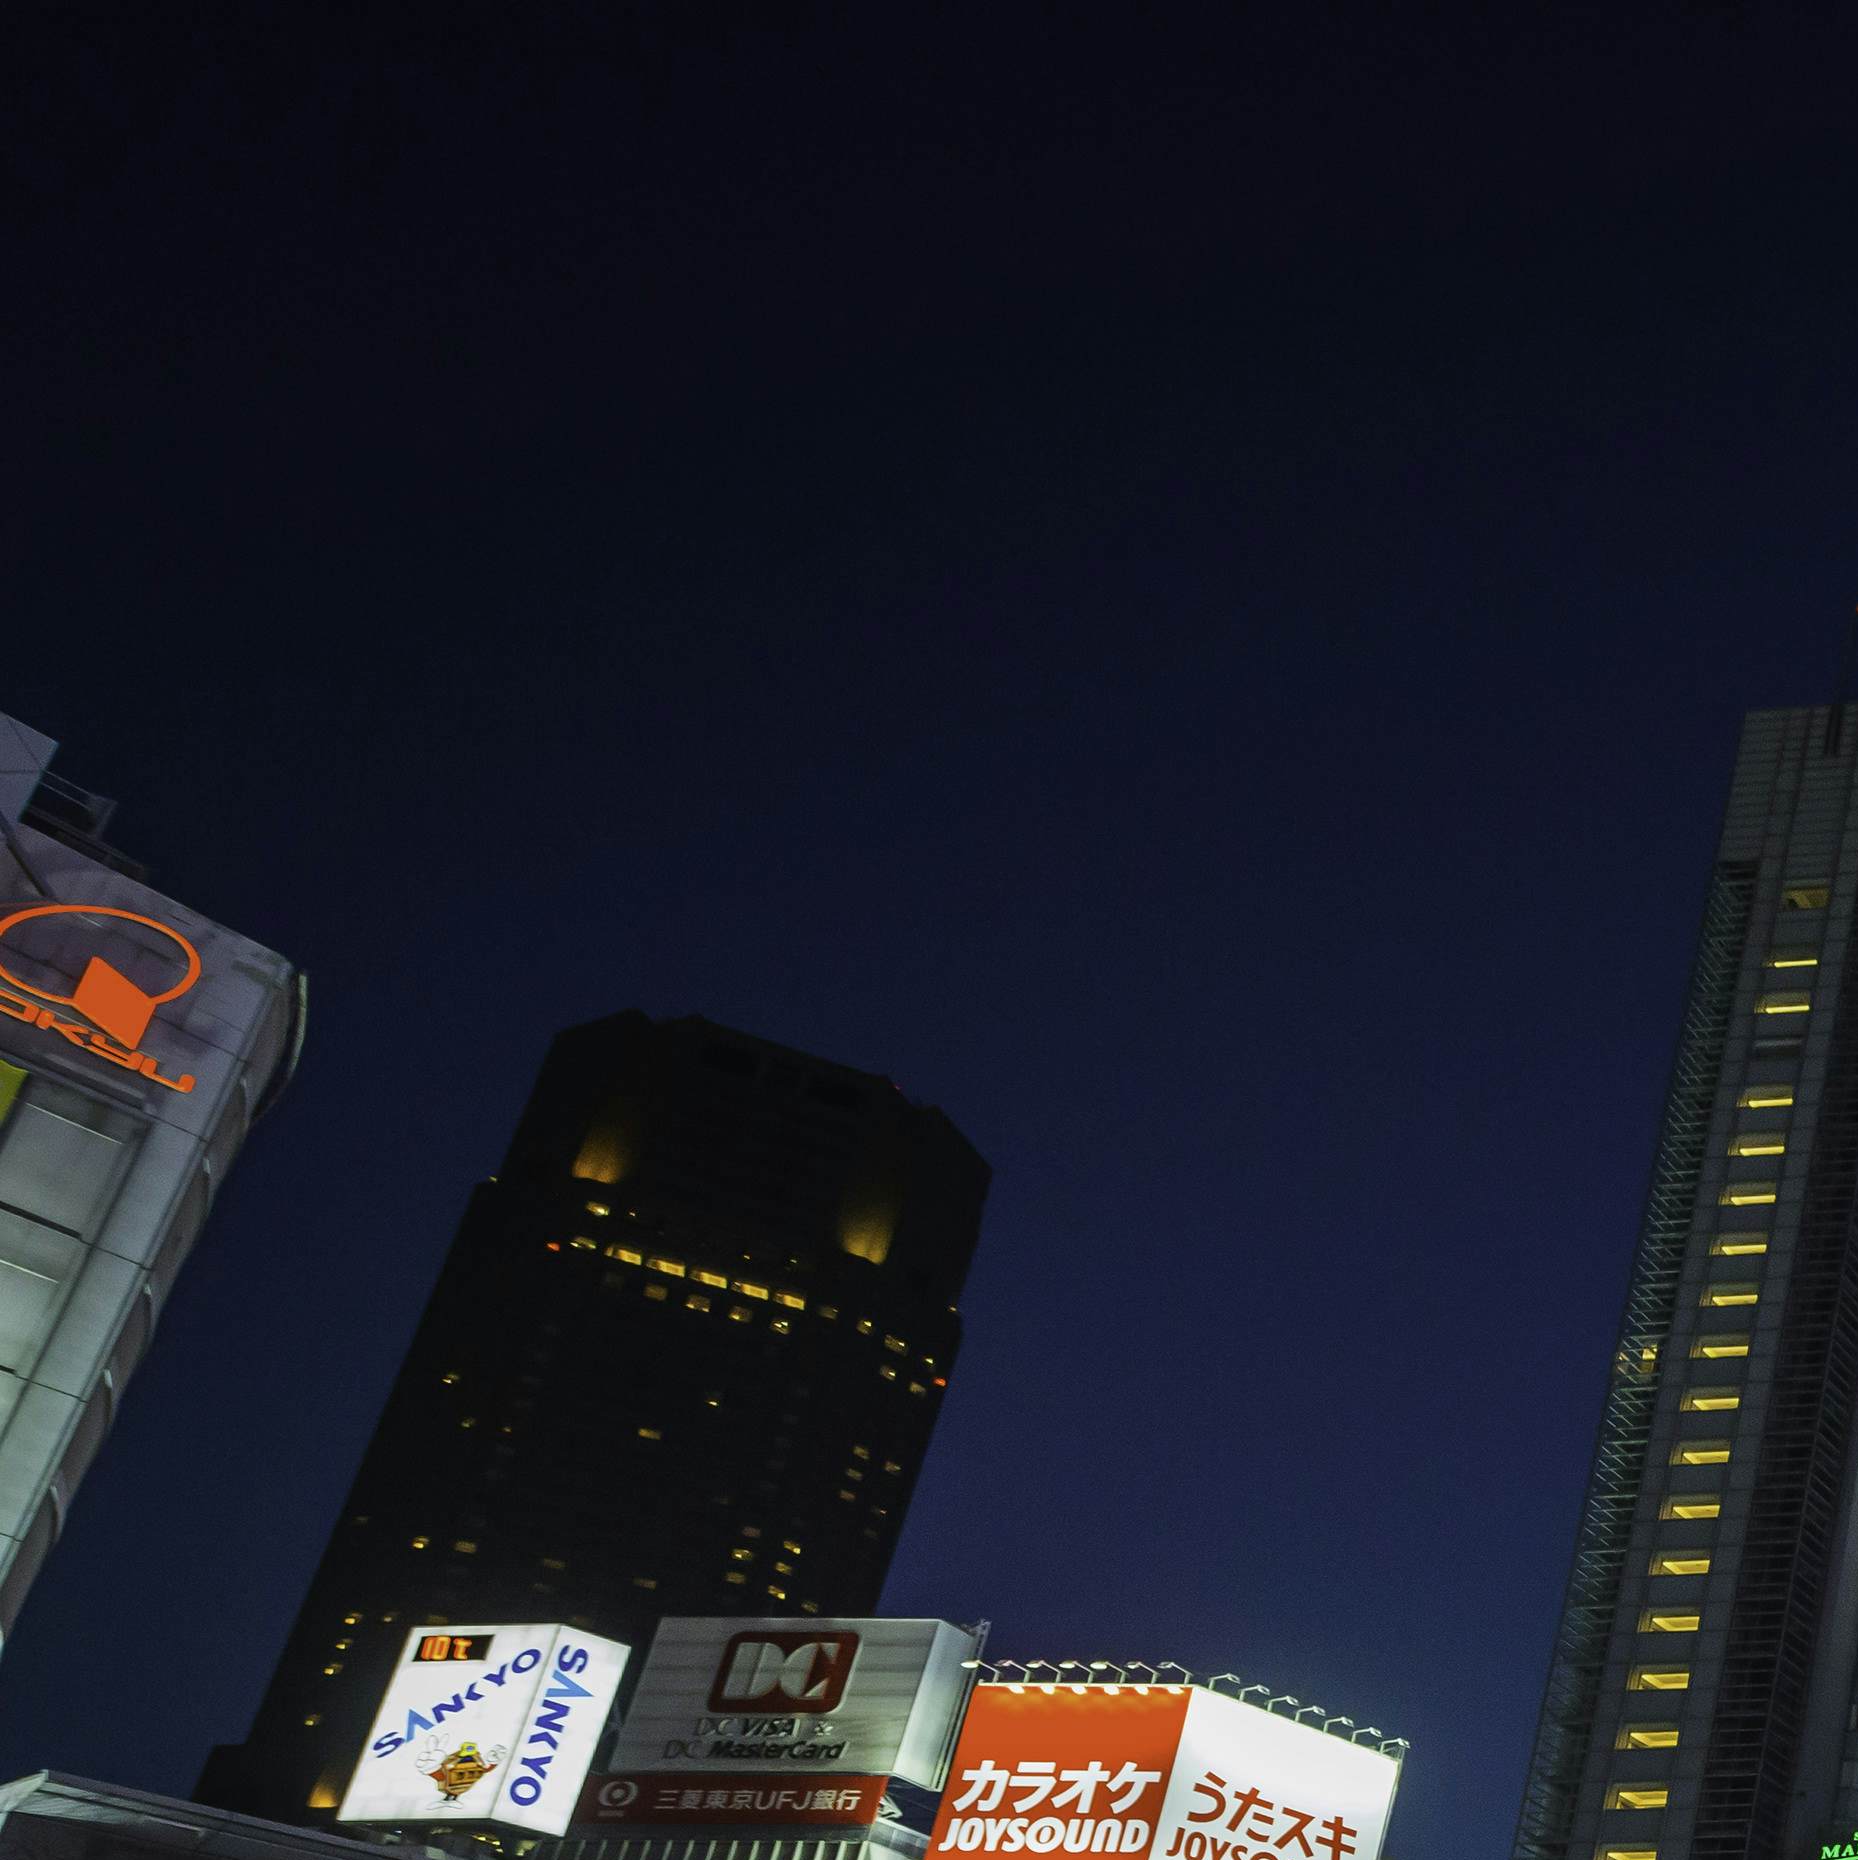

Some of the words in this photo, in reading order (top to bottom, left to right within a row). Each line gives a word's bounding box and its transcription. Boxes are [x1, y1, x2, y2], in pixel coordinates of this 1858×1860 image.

[373, 1648, 541, 1758] SANKYO
[509, 1644, 594, 1806] SANKYO
[653, 1788, 863, 1812] 三菱東京UFJ銀行
[952, 1760, 1163, 1814] カラオケ
[938, 1816, 1150, 1853] JOYSOUND
